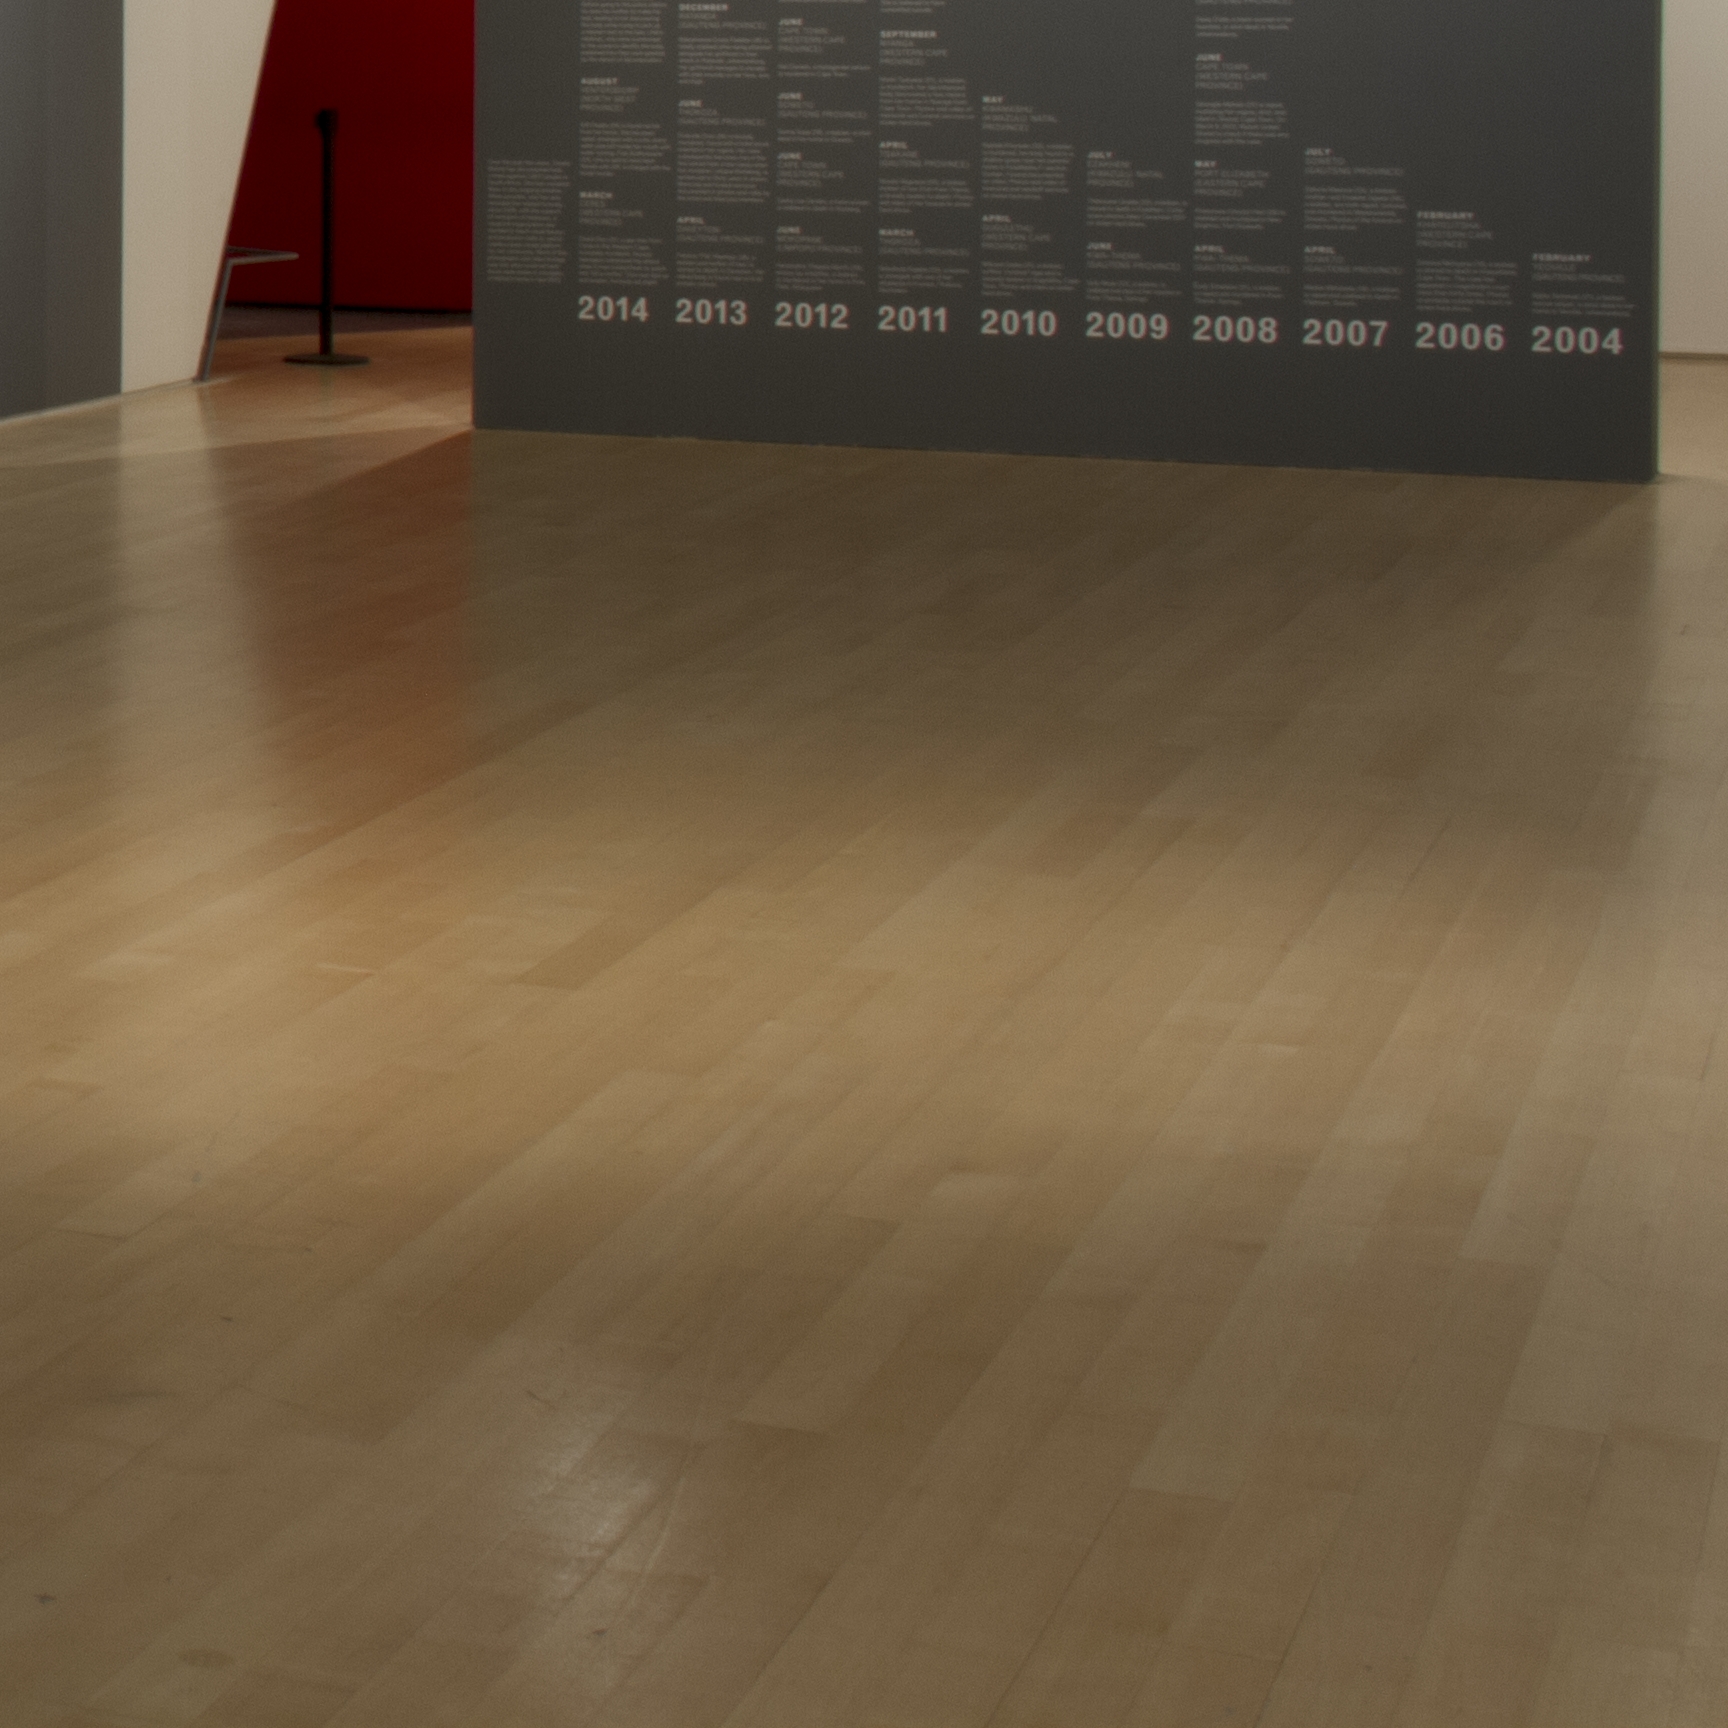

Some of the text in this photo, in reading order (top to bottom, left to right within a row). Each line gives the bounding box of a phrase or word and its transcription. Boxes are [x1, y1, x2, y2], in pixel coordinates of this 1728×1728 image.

[581, 77, 617, 85] AUGUST
[1417, 210, 1474, 219] FEBRUARY
[1532, 253, 1590, 262] FEBRUARY
[579, 296, 648, 321] 2014
[676, 299, 746, 325] 2013
[775, 302, 848, 328] 2012
[878, 306, 946, 332] 2011
[981, 309, 1056, 336] 2010
[1086, 312, 1168, 339] 2009
[1193, 315, 1277, 343] 2008
[1303, 319, 1387, 346] 2007
[1416, 322, 1504, 351] 2006
[1532, 326, 1622, 354] 2004
